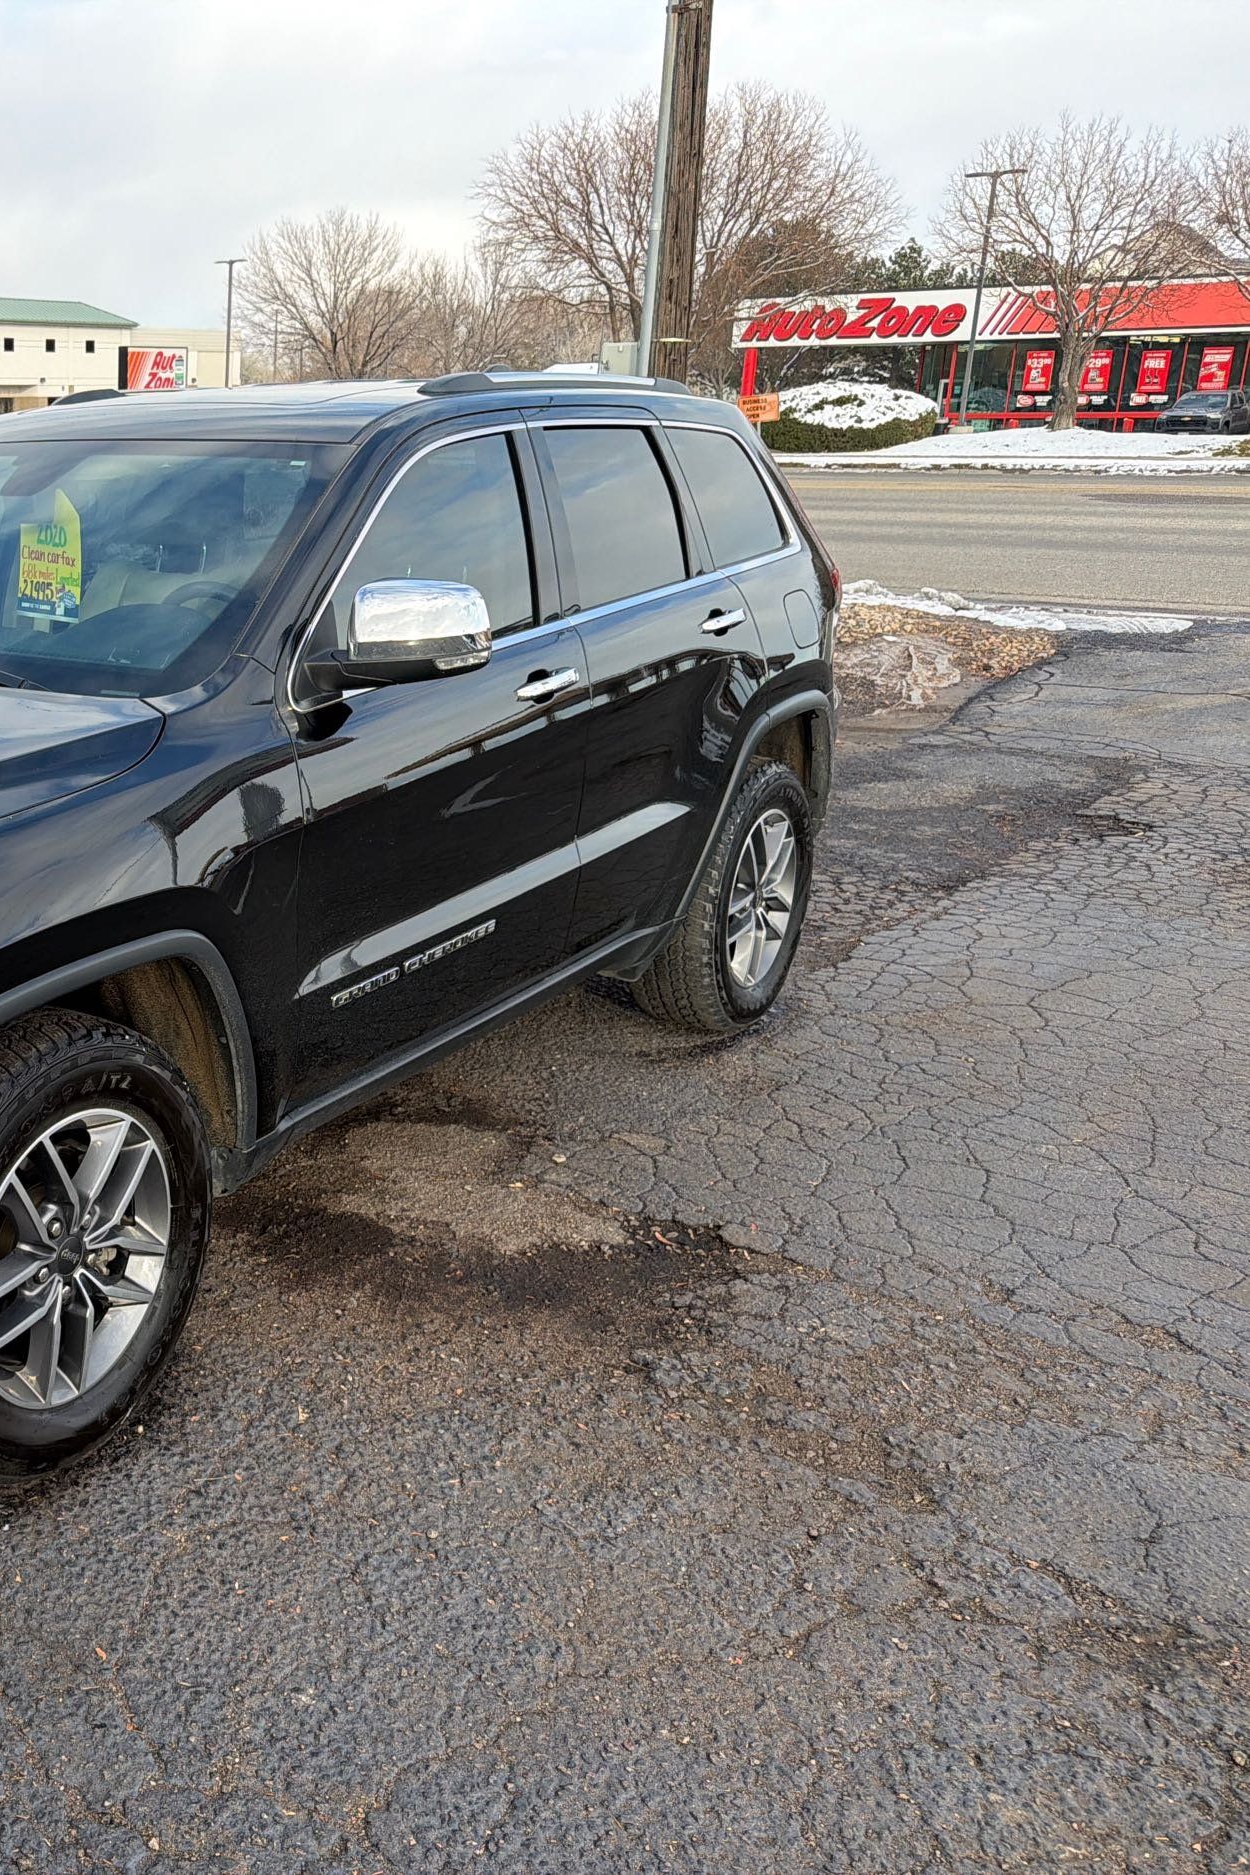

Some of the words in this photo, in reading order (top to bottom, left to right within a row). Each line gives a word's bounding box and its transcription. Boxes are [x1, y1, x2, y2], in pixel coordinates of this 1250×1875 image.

[740, 297, 967, 342] AutoZone
[151, 351, 176, 370] Aut
[1144, 359, 1166, 369] FREE
[37, 524, 68, 547] 2020
[21, 545, 46, 561] Clean
[331, 966, 400, 1008] GRAND
[403, 918, 497, 973] CHEROKEE
